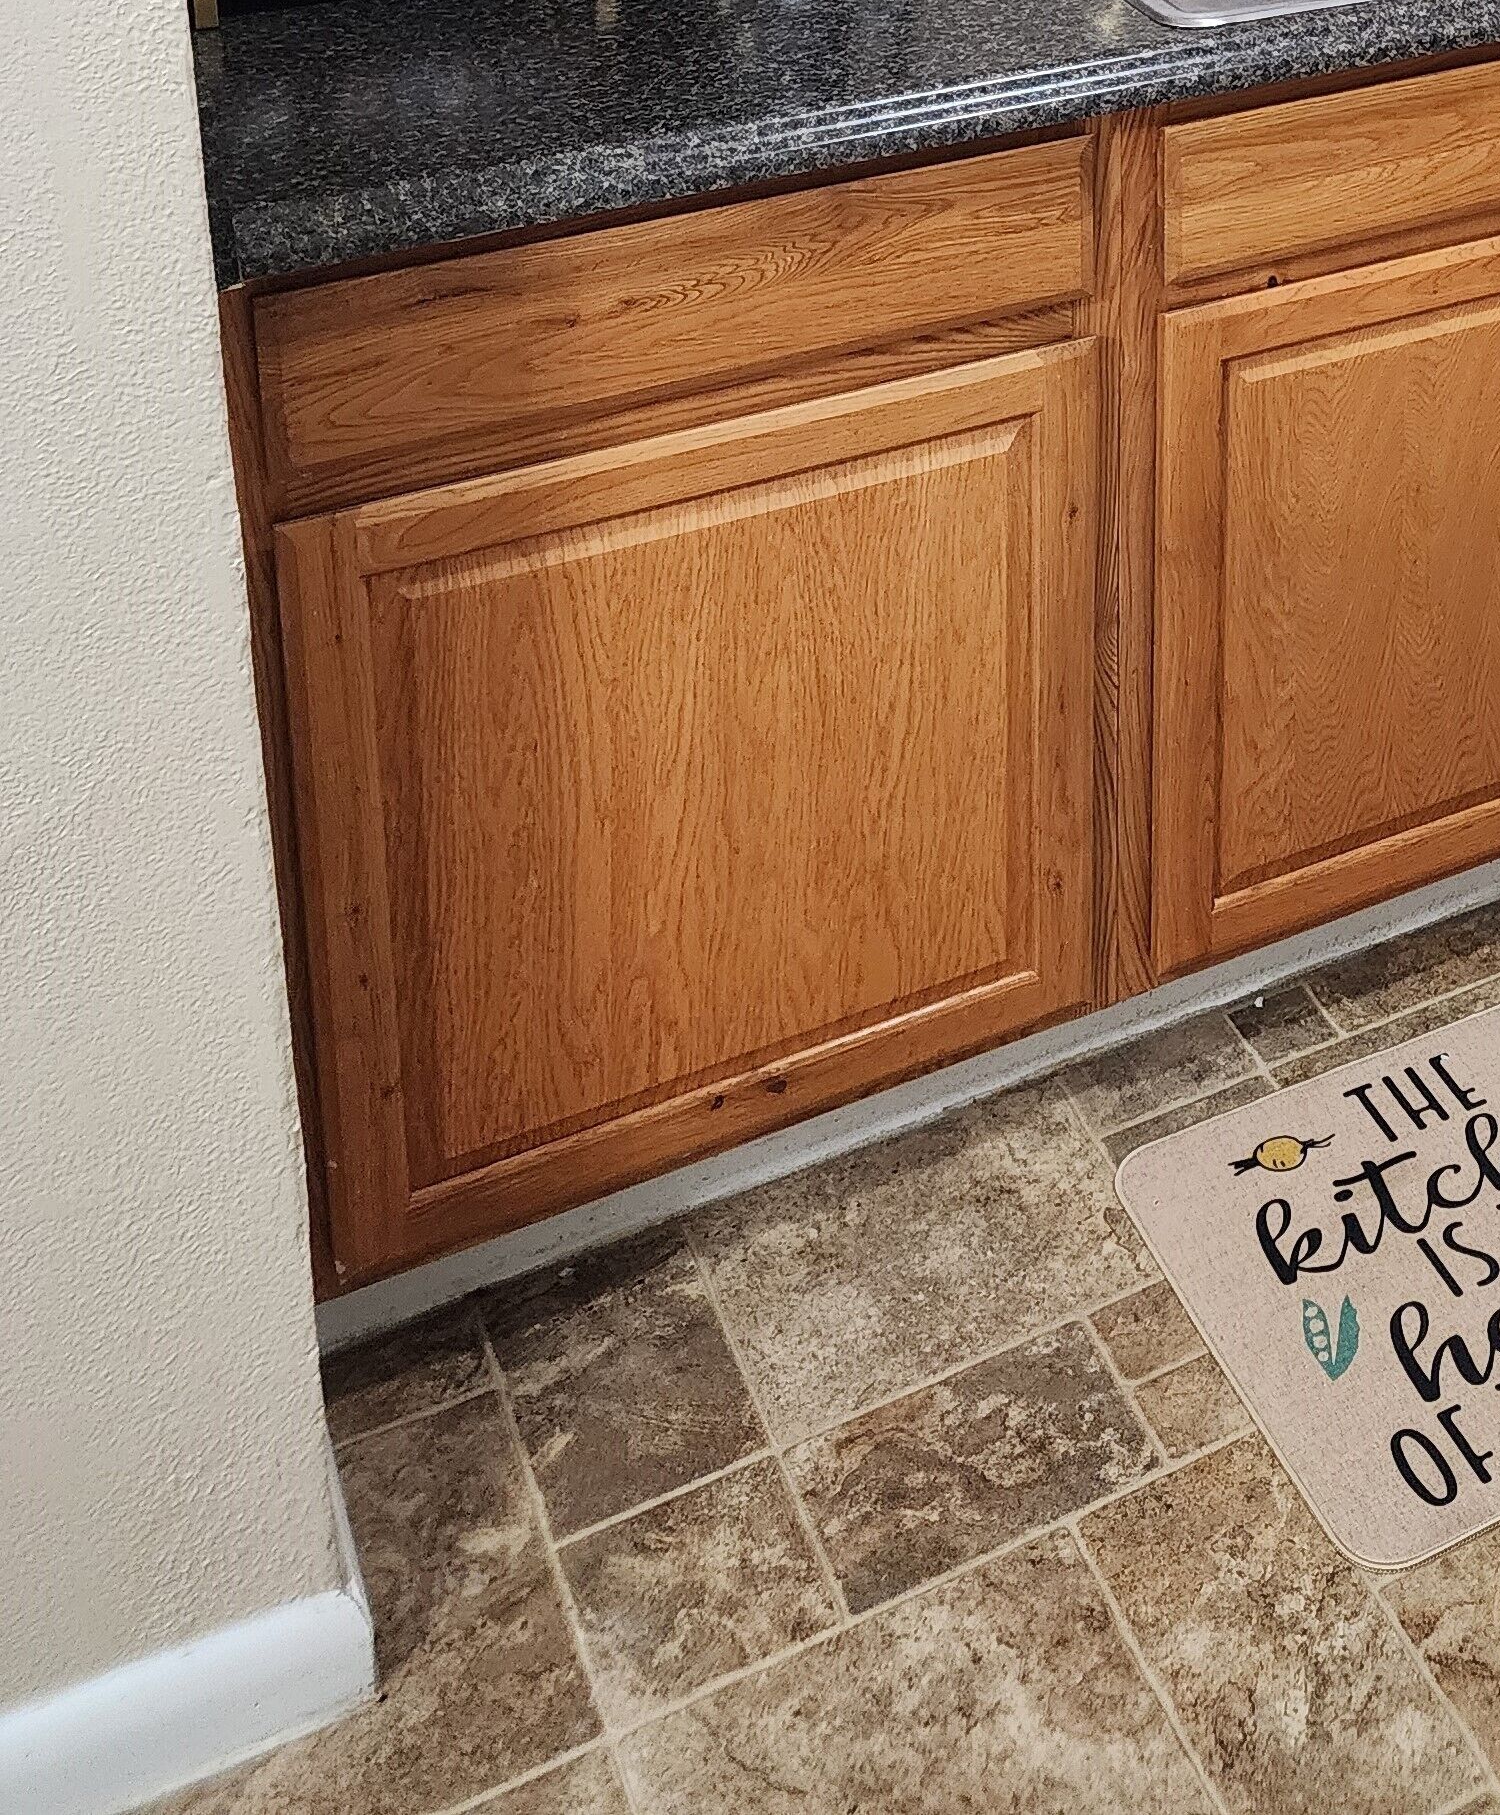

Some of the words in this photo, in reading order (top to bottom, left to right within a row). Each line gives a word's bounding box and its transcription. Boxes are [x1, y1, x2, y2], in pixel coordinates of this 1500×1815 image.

[1342, 1052, 1488, 1143] THE
[1415, 1221, 1500, 1298] IS
[1389, 1404, 1494, 1507] OF
